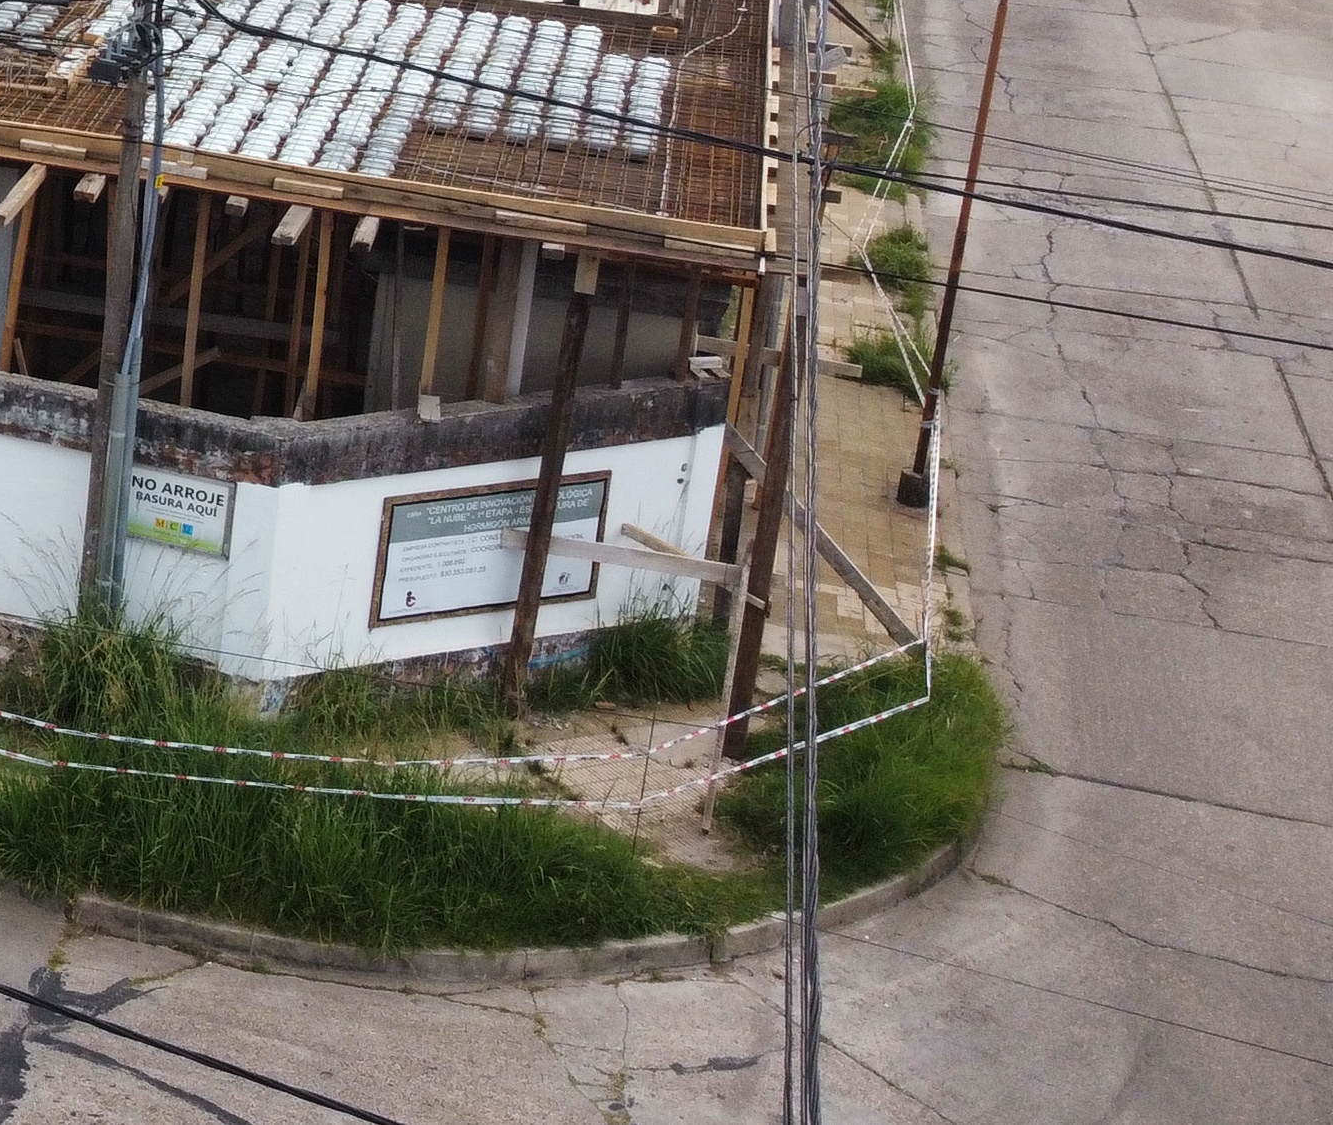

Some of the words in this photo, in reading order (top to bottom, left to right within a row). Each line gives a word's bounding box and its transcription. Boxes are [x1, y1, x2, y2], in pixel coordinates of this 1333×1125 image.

[132, 475, 157, 491] NO
[161, 482, 225, 507] ARROJE
[136, 491, 184, 510] BASURA
[187, 503, 218, 517] AQUÍ
[466, 501, 479, 511] DE
[480, 494, 532, 509] INNOVACIÓN
[486, 507, 513, 518] ETAPA
[577, 498, 590, 508] DE
[464, 519, 510, 532] HORMIGÓN
